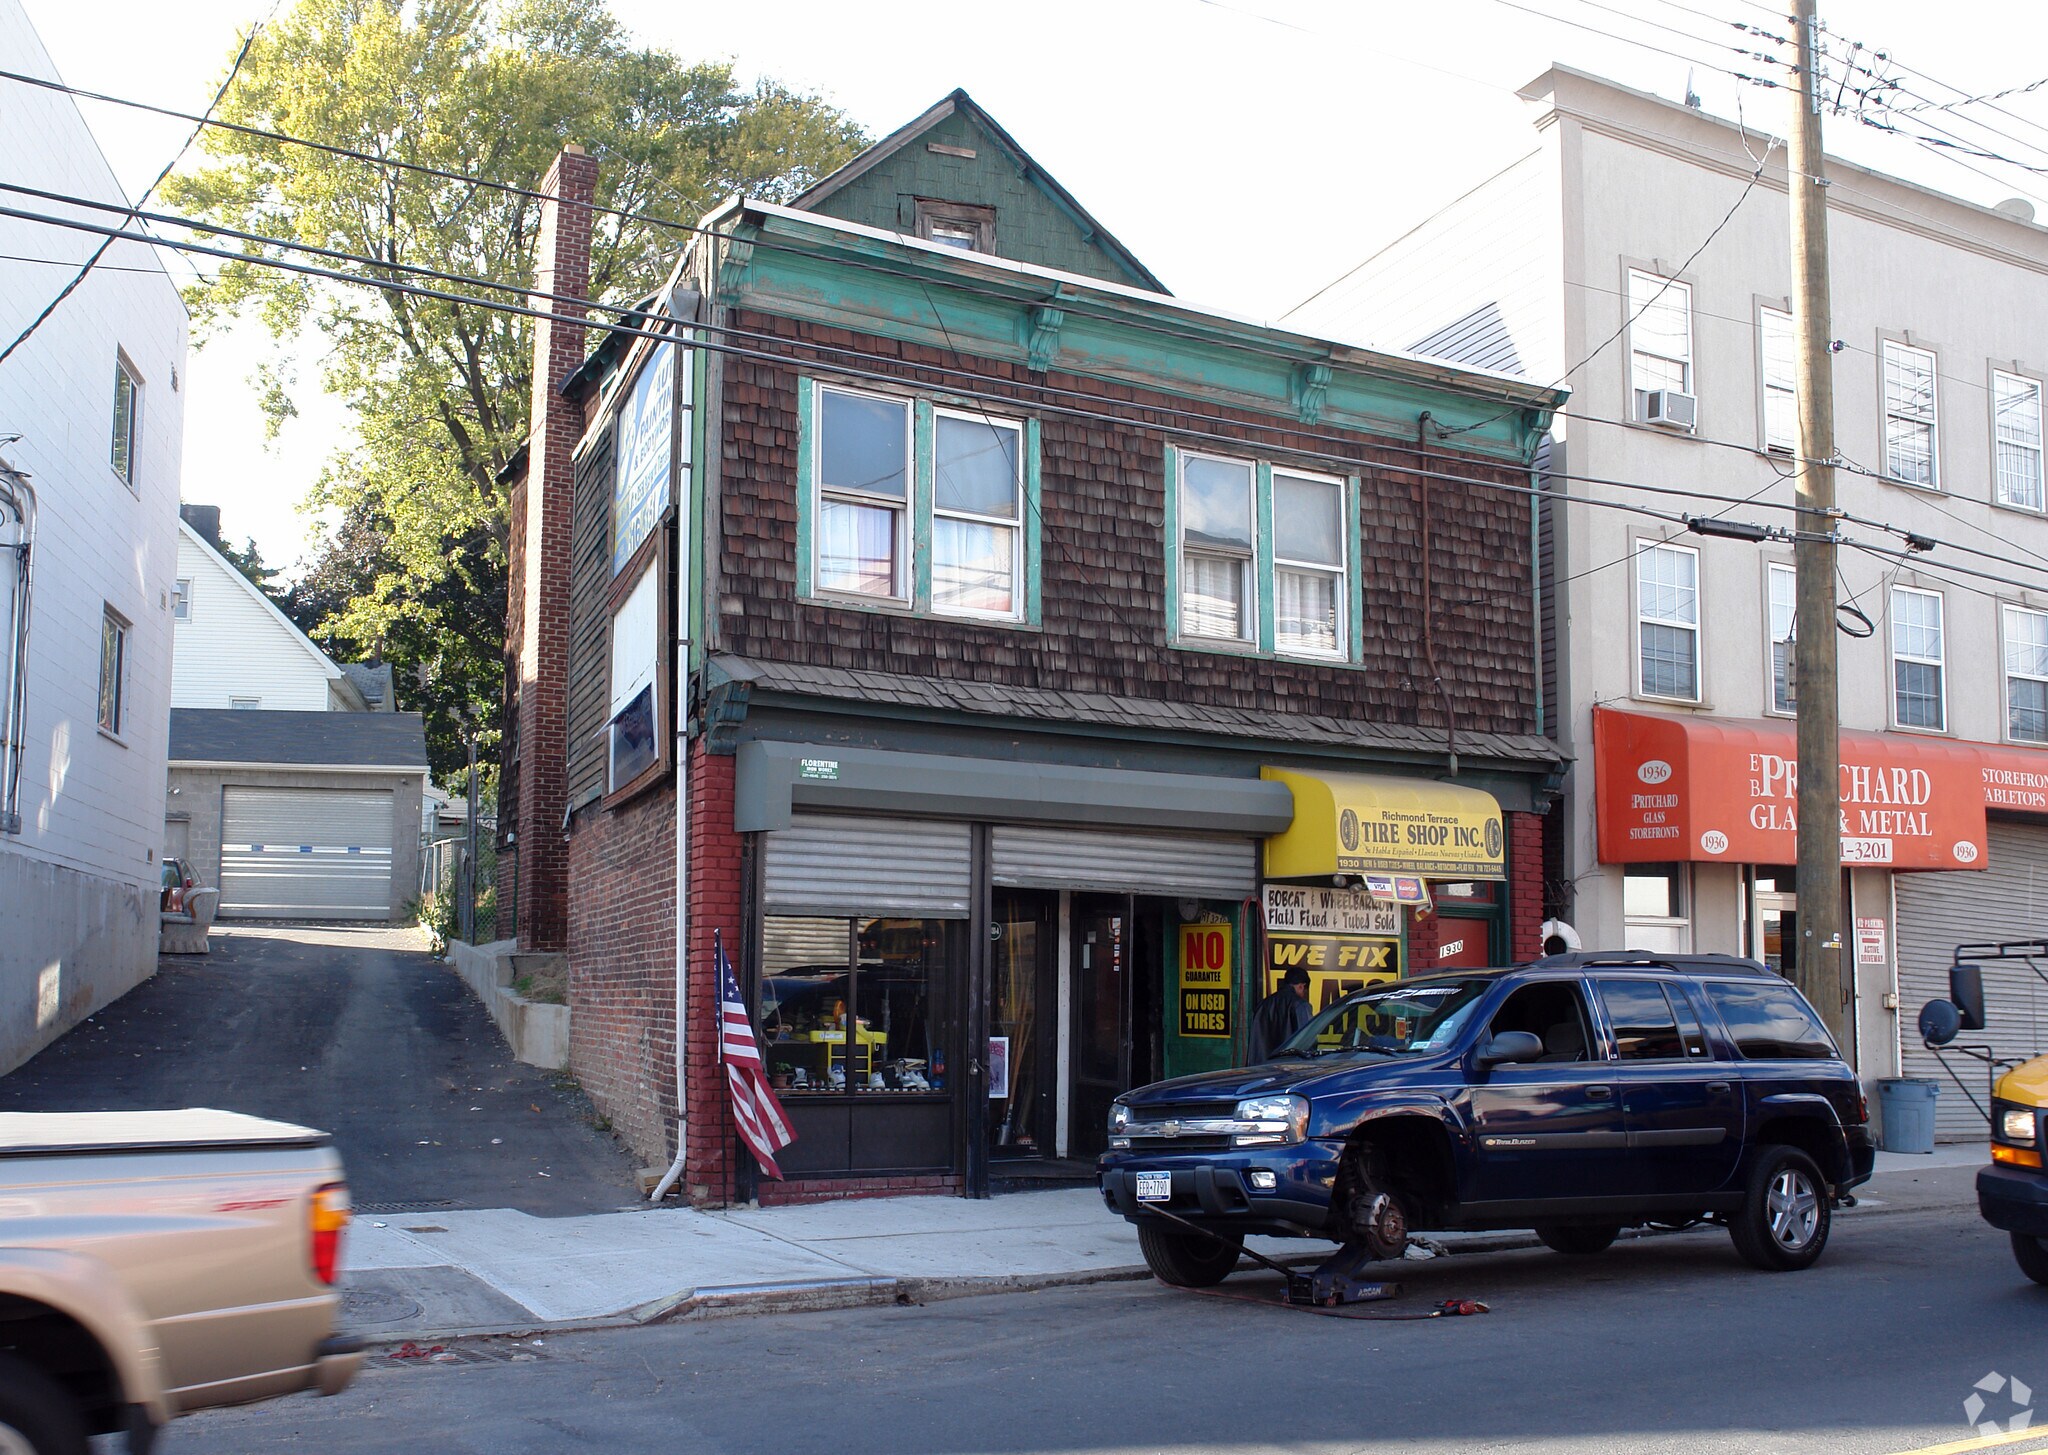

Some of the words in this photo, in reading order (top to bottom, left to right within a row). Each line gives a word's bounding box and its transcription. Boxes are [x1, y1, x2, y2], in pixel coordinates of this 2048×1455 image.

[1643, 764, 1667, 779] 1936
[1759, 754, 1931, 805] PRCHARD
[1632, 794, 1678, 809] PRITCHARD
[1983, 788, 2046, 807] ABLETOPS
[1382, 811, 1426, 823] Richmond
[1427, 814, 1458, 824] Terrace
[1643, 811, 1666, 824] GLASS
[1859, 809, 1932, 836] METAL
[1362, 822, 1400, 844] TIRE
[1407, 824, 1448, 845] SHOP
[1454, 827, 1484, 848] INC.
[1630, 826, 1680, 839] STOREFRONTS
[1372, 846, 1391, 855] Habla
[1705, 836, 1725, 849] 1936
[1957, 845, 1975, 859] 1936
[1339, 860, 1359, 868] 1930
[1268, 890, 1306, 908] BOBCAT
[1320, 891, 1394, 912] WHEELBARROW
[1268, 908, 1294, 925] Flats
[1300, 909, 1328, 928] Fixed
[1342, 912, 1370, 929] Tubes
[1375, 913, 1395, 930] Sold
[1186, 931, 1224, 969] NO
[1274, 943, 1327, 966] WE
[1338, 946, 1391, 968] FIX
[1441, 941, 1462, 957] 1930
[1185, 971, 1221, 982] GUARANTEE
[1185, 994, 1199, 1011] ON
[1200, 994, 1225, 1011] USED
[1186, 1013, 1225, 1030] TIRES
